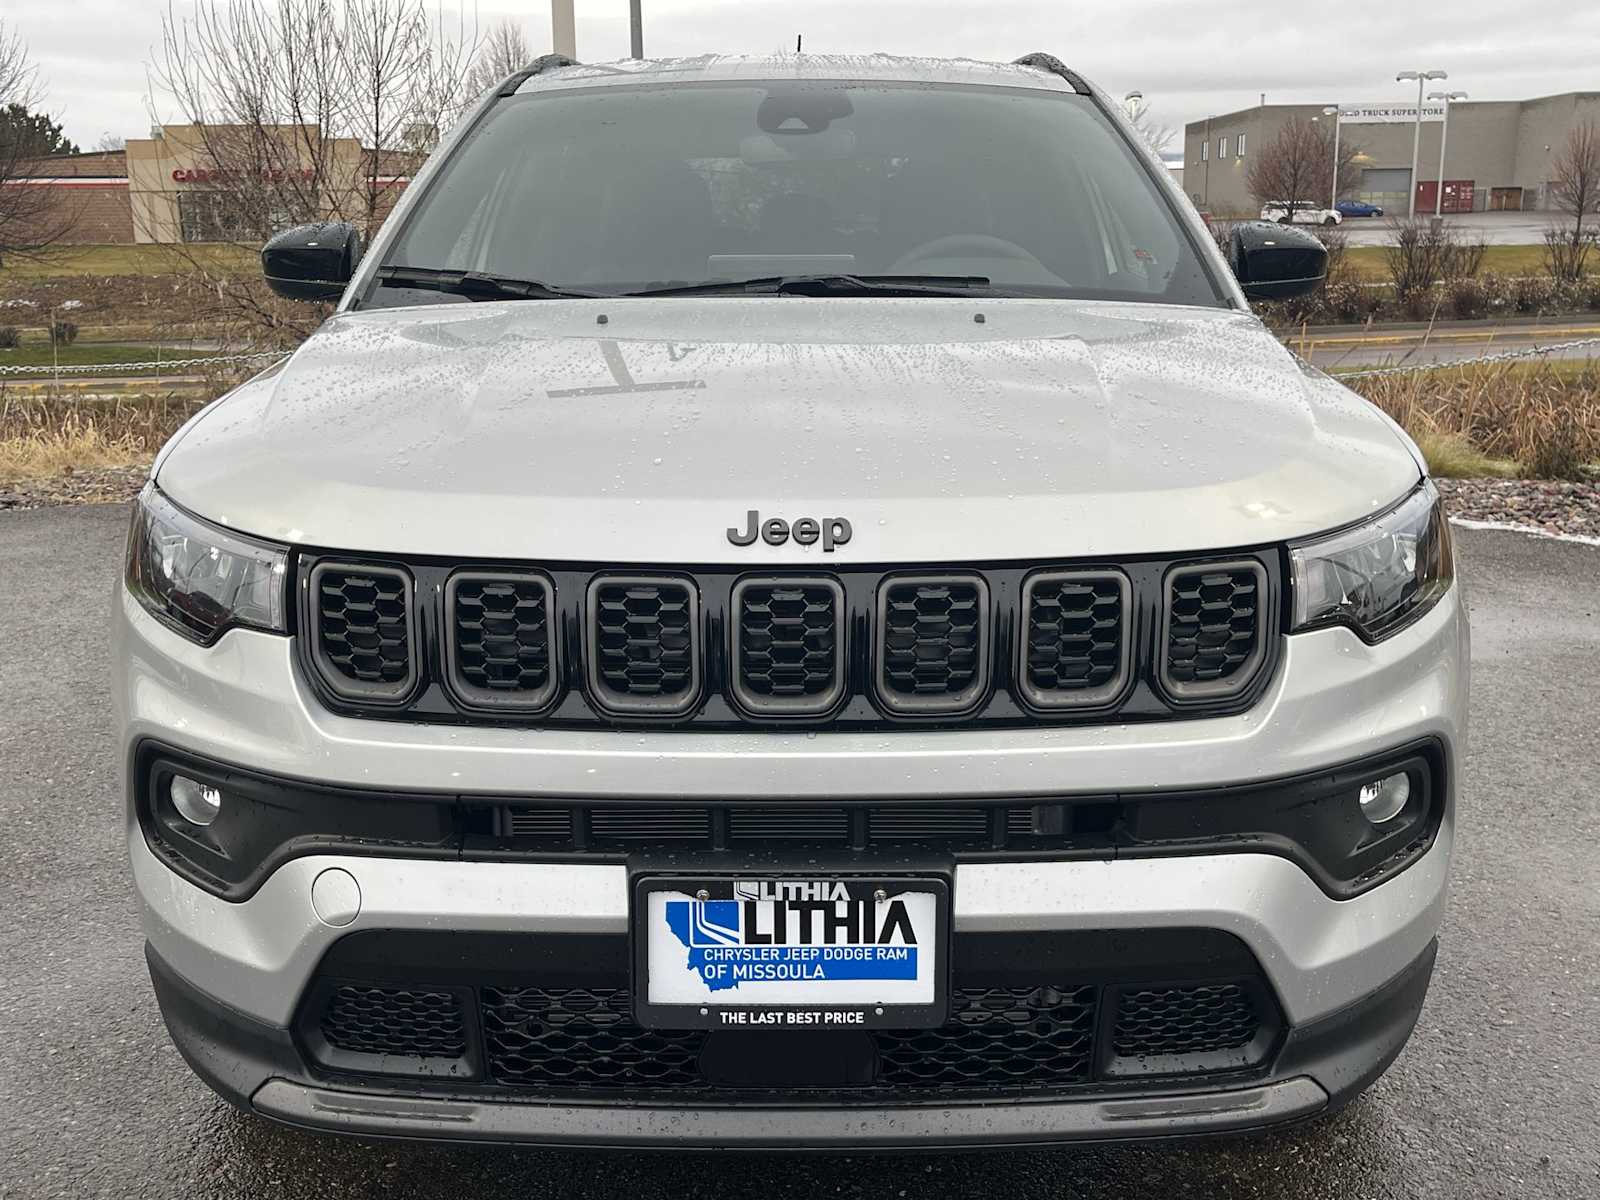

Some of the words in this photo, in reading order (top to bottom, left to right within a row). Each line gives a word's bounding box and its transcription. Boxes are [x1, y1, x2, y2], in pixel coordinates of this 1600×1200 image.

[1362, 109, 1390, 117] TRUCK
[1391, 108, 1444, 117] SUPERTORE
[727, 510, 853, 552] Jeep
[758, 881, 851, 902] LITHIA
[743, 900, 918, 945] LITHIA
[703, 948, 779, 961] CHRYSLER
[783, 948, 820, 961] JEEP
[824, 948, 873, 961] DODGE
[876, 947, 908, 960] RAM
[703, 964, 727, 980] OF
[732, 963, 825, 980] MISSOULA
[719, 1012, 747, 1025] THE
[749, 1012, 783, 1025] LAST
[786, 1012, 820, 1025] BEST
[824, 1012, 865, 1025] PRICE
